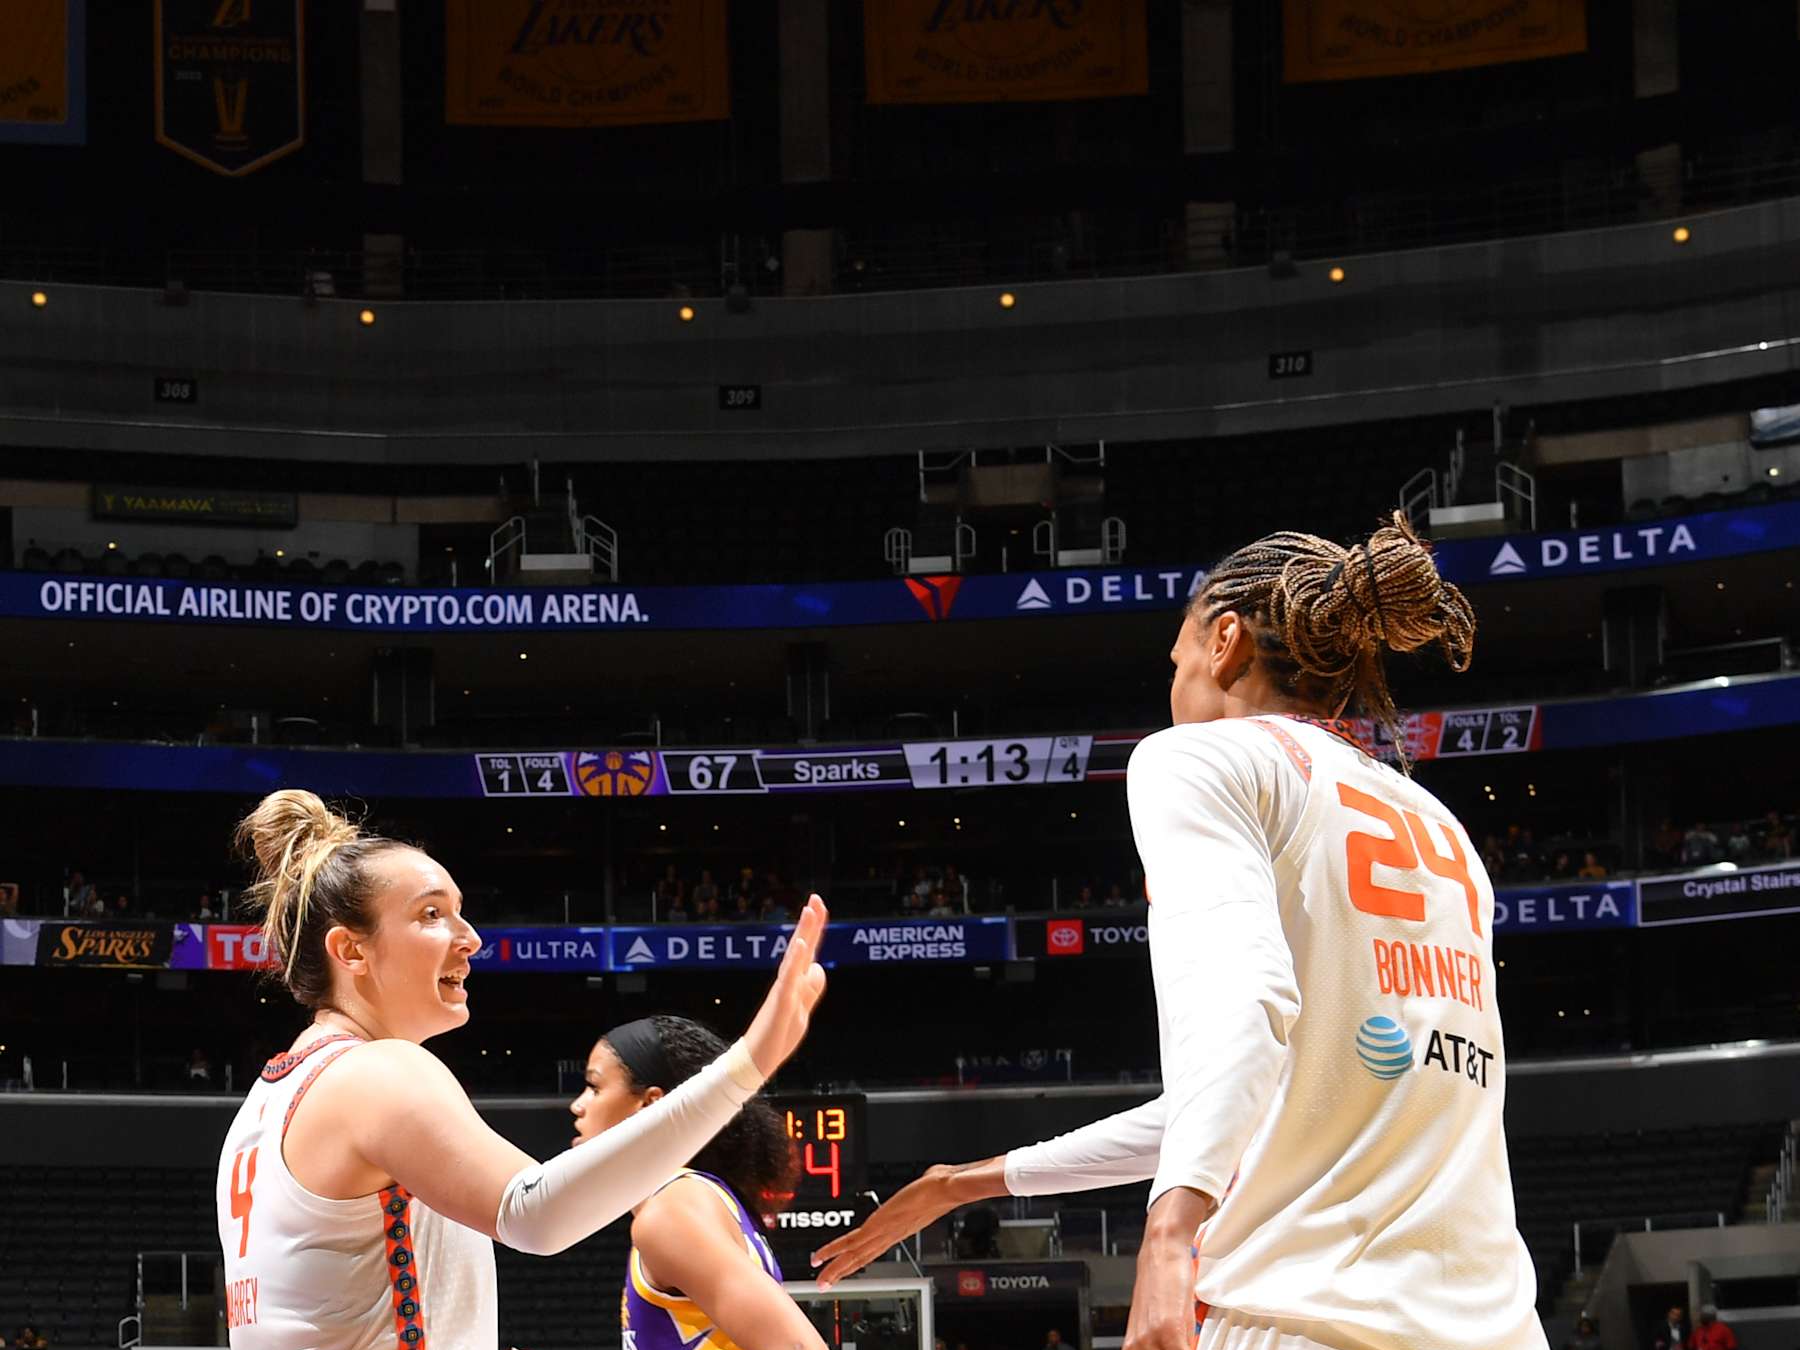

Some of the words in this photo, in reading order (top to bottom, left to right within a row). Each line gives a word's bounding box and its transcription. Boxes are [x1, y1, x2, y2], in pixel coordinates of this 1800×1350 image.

[1275, 356, 1305, 374] 310
[161, 383, 190, 399] 308
[727, 389, 755, 405] 309
[1541, 524, 1696, 567] DELTA
[40, 580, 171, 616] OFFICIAL
[178, 586, 292, 620] AIRLINE
[300, 591, 338, 622] OF
[345, 593, 533, 625] CRYPTO.COM
[541, 593, 649, 624] ARENA.
[1449, 715, 1488, 728] FOULS
[1457, 729, 1475, 750] 4
[1502, 726, 1518, 749] 2
[489, 758, 512, 770] TOL
[525, 756, 560, 769] FOULS
[688, 755, 739, 790] 67
[793, 759, 881, 785] Sparks
[929, 743, 1031, 785] 1:13
[1062, 752, 1081, 780] 4
[498, 770, 510, 792] 1
[537, 770, 554, 792] 4
[1336, 782, 1483, 938] 24
[1683, 877, 1747, 899] Crystal
[1494, 893, 1620, 925] DELTA
[852, 925, 965, 945] AMERICAN
[1089, 925, 1148, 944] TOYO
[516, 940, 597, 960] ULTRA
[868, 943, 967, 961] EXPRESS
[1373, 937, 1484, 1013] BONNER
[1423, 1029, 1495, 1089] AT&T
[786, 1108, 845, 1141] 1:13
[230, 1147, 259, 1259] 4
[777, 1210, 855, 1229] TISSOT
[990, 1275, 1050, 1290] TOYOTA
[226, 1277, 258, 1329] ABREY
